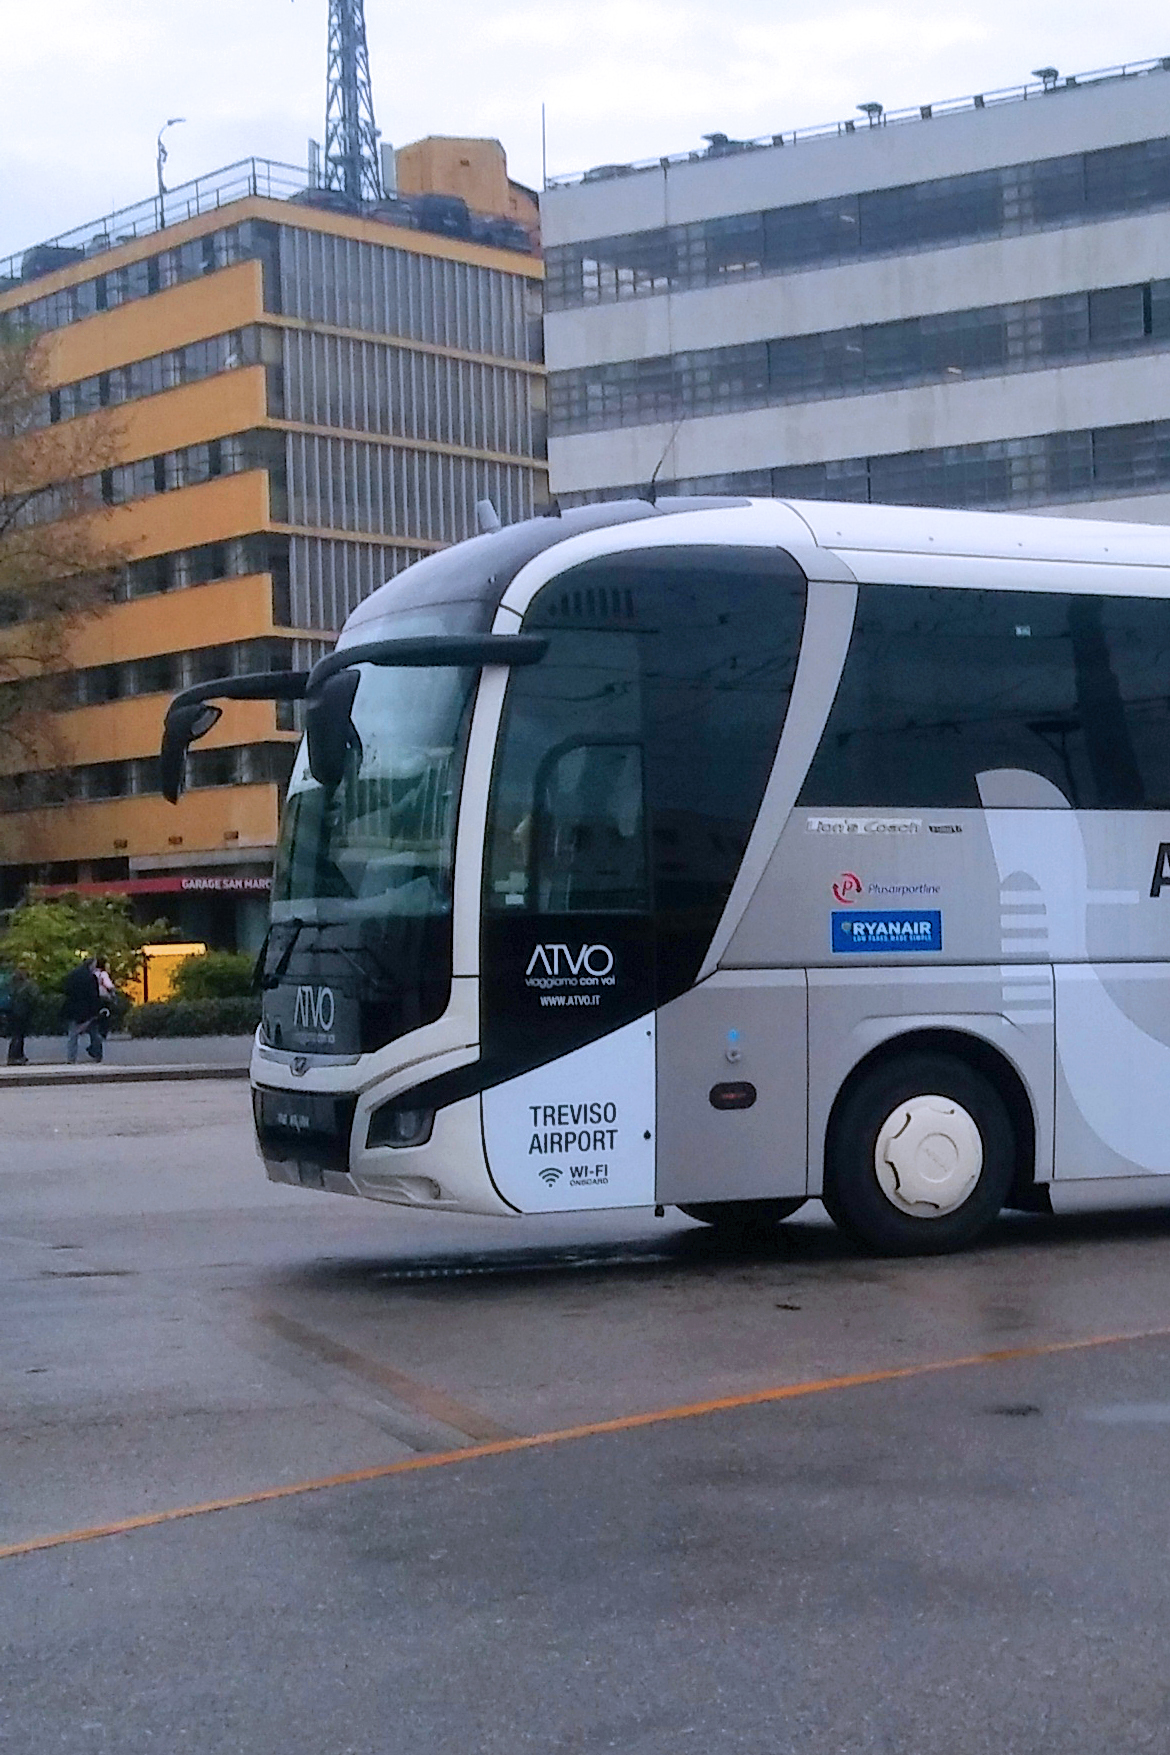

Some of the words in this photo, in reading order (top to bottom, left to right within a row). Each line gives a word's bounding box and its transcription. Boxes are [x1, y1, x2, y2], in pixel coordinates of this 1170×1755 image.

[181, 879, 221, 890] GARAGE
[222, 878, 243, 889] SAN
[868, 884, 941, 896] Plusairportline
[852, 921, 932, 936] RYANAIR
[525, 944, 614, 976] ATVO
[525, 977, 578, 989] viaggiamo
[579, 977, 599, 986] con
[600, 975, 616, 986] voi
[293, 985, 335, 1031] ATVO
[540, 995, 601, 1007] WWW.ATVO.IT
[528, 1102, 617, 1127] TREVISO
[528, 1129, 619, 1155] AIRPORT
[569, 1164, 608, 1178] WI-FI
[569, 1177, 609, 1187] ONBOARD
